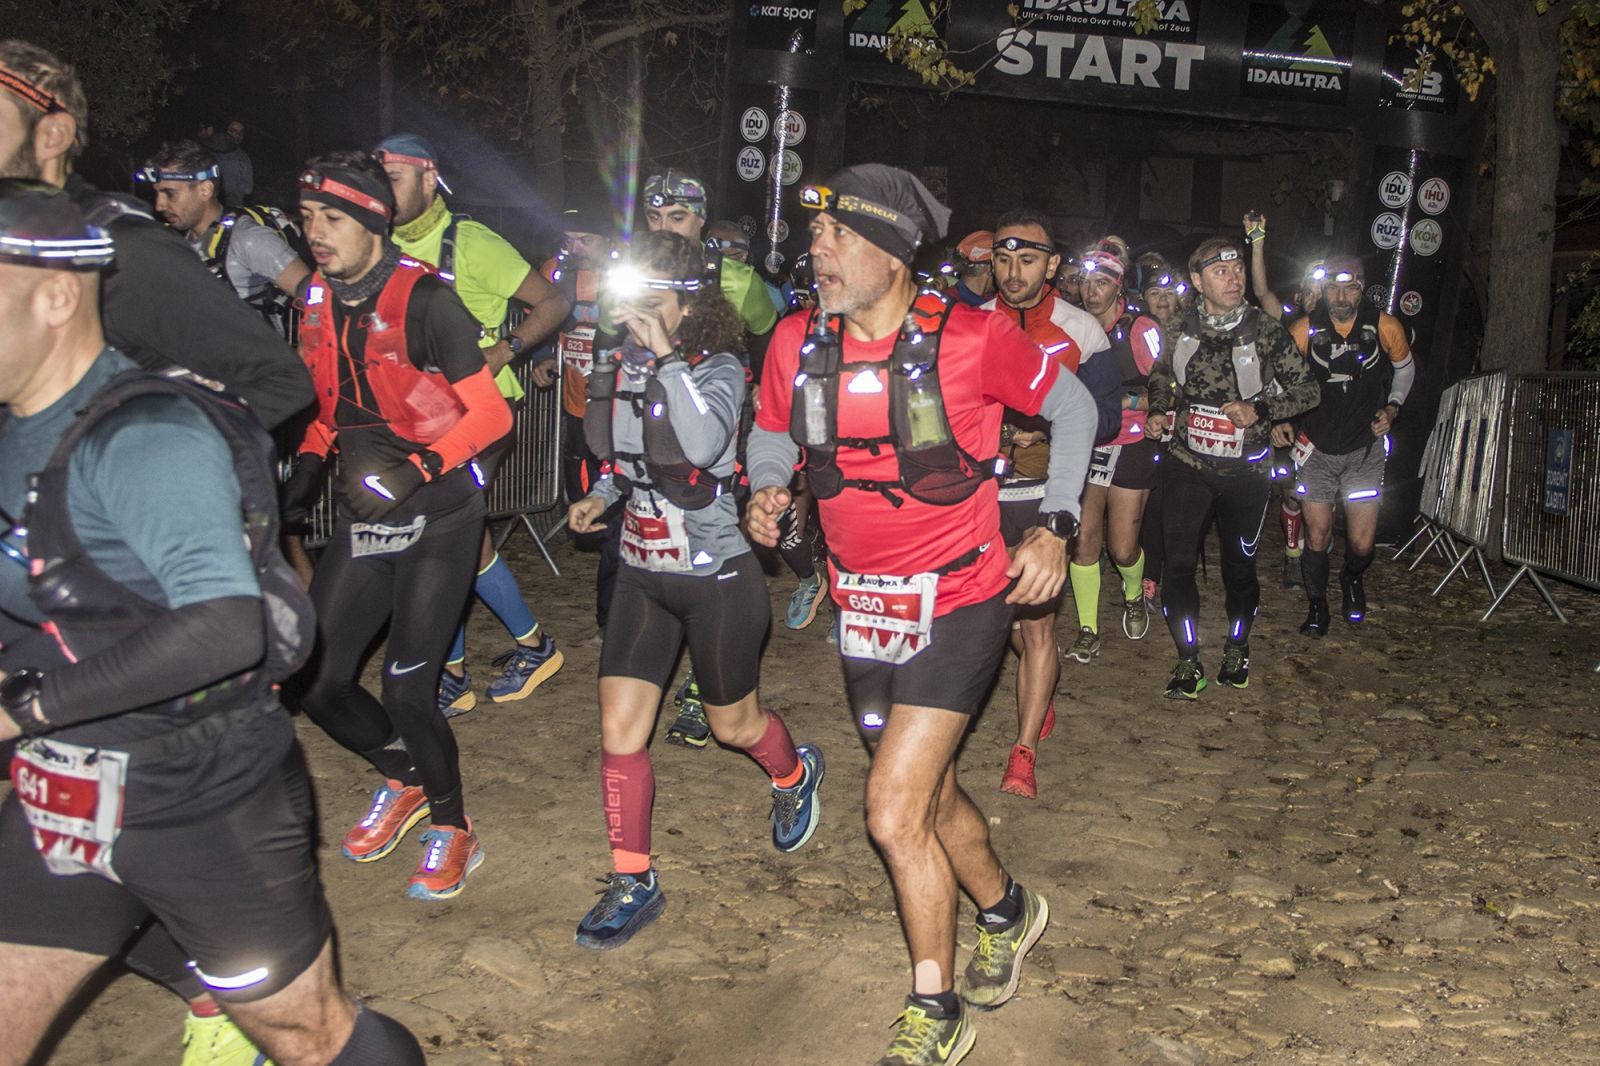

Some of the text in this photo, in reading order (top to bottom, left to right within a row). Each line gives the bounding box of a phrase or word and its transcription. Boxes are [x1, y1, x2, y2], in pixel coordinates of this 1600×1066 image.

[761, 6, 814, 20] kar spor
[1023, 0, 1191, 22] ULRA
[1022, 11, 1044, 20] Ultr
[1046, 13, 1064, 22] Trail
[1066, 15, 1088, 24] Race
[1090, 17, 1110, 25] Over
[1112, 19, 1127, 27] the
[1170, 24, 1191, 33] Zeus
[993, 28, 1206, 91] START
[740, 157, 760, 169] RUZ
[860, 202, 898, 222] FORCLAZ
[1376, 223, 1400, 236] RUZ
[567, 339, 584, 352] 623
[1193, 416, 1214, 430] 604
[848, 594, 885, 614] 680
[17, 766, 49, 805] 641
